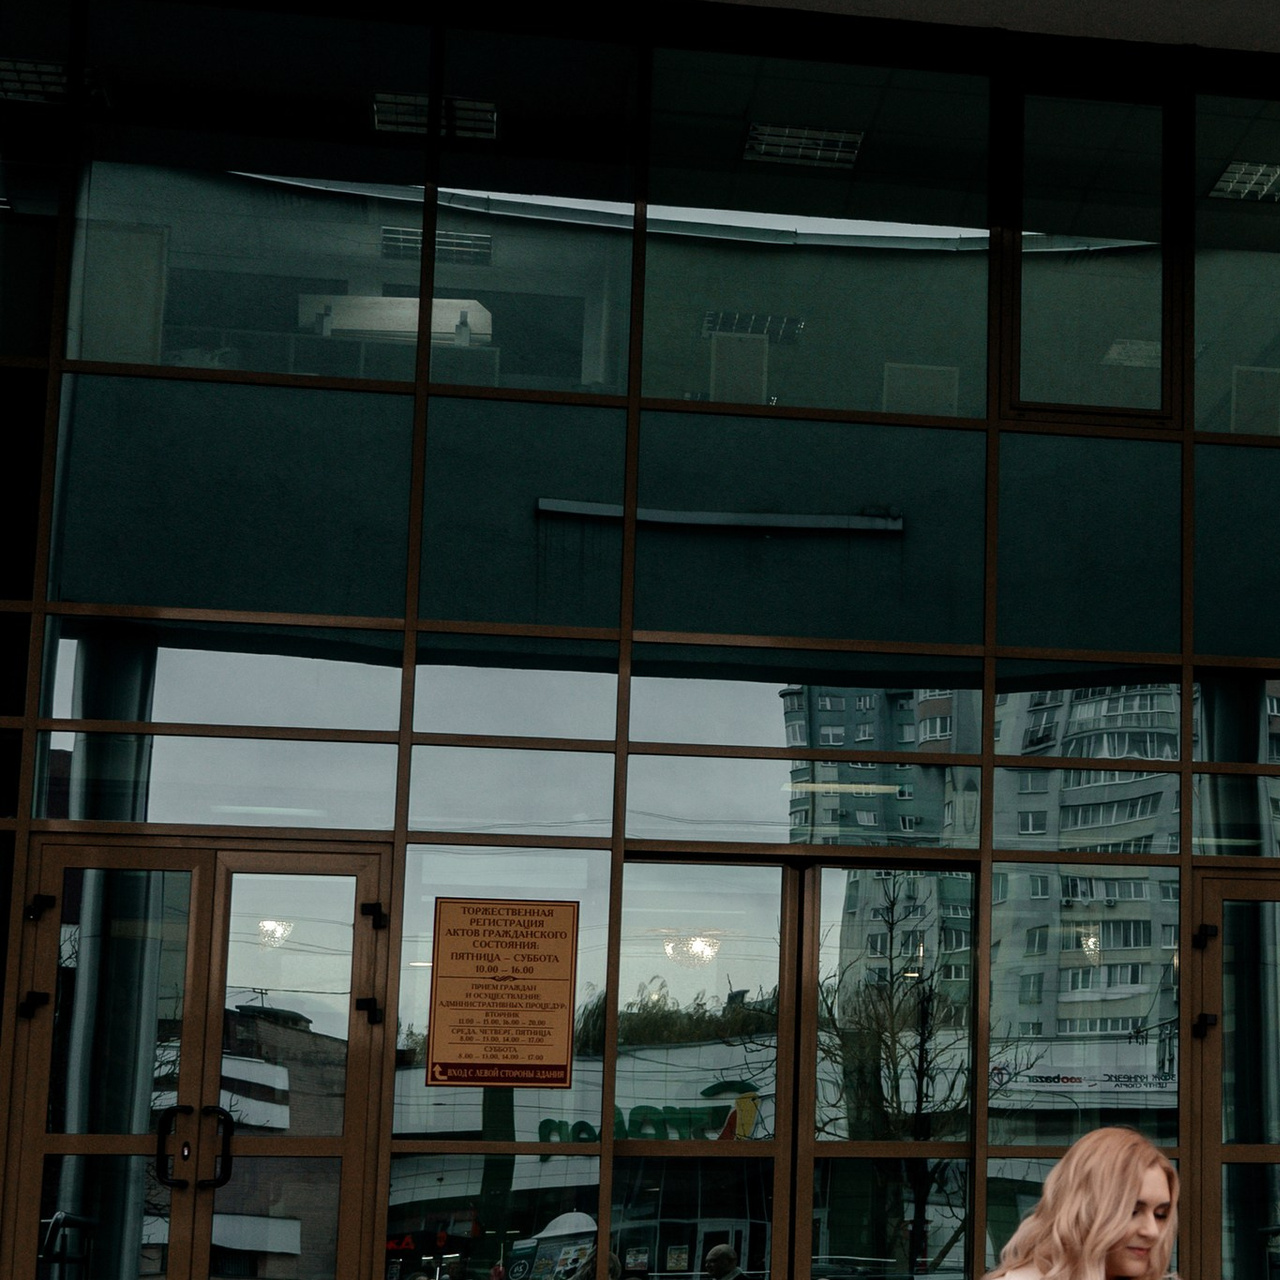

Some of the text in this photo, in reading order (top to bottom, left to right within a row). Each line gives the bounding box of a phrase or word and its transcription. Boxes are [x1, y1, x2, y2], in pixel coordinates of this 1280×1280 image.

[461, 907, 554, 917] ТОРЖЕСТВЕННАЯ
[469, 918, 545, 929] РЕГИСТРАЦИЯ
[445, 928, 568, 939] АКТОВ ГРАЖДАНСКОГО
[472, 940, 540, 950] СОСТОЯНИЯ:
[450, 952, 501, 963] ПЯТНИЦА
[513, 954, 560, 963] СУББОТА
[475, 965, 499, 973] 10.00
[511, 966, 534, 974] 16.00
[500, 984, 537, 992] ГРАЖДАН
